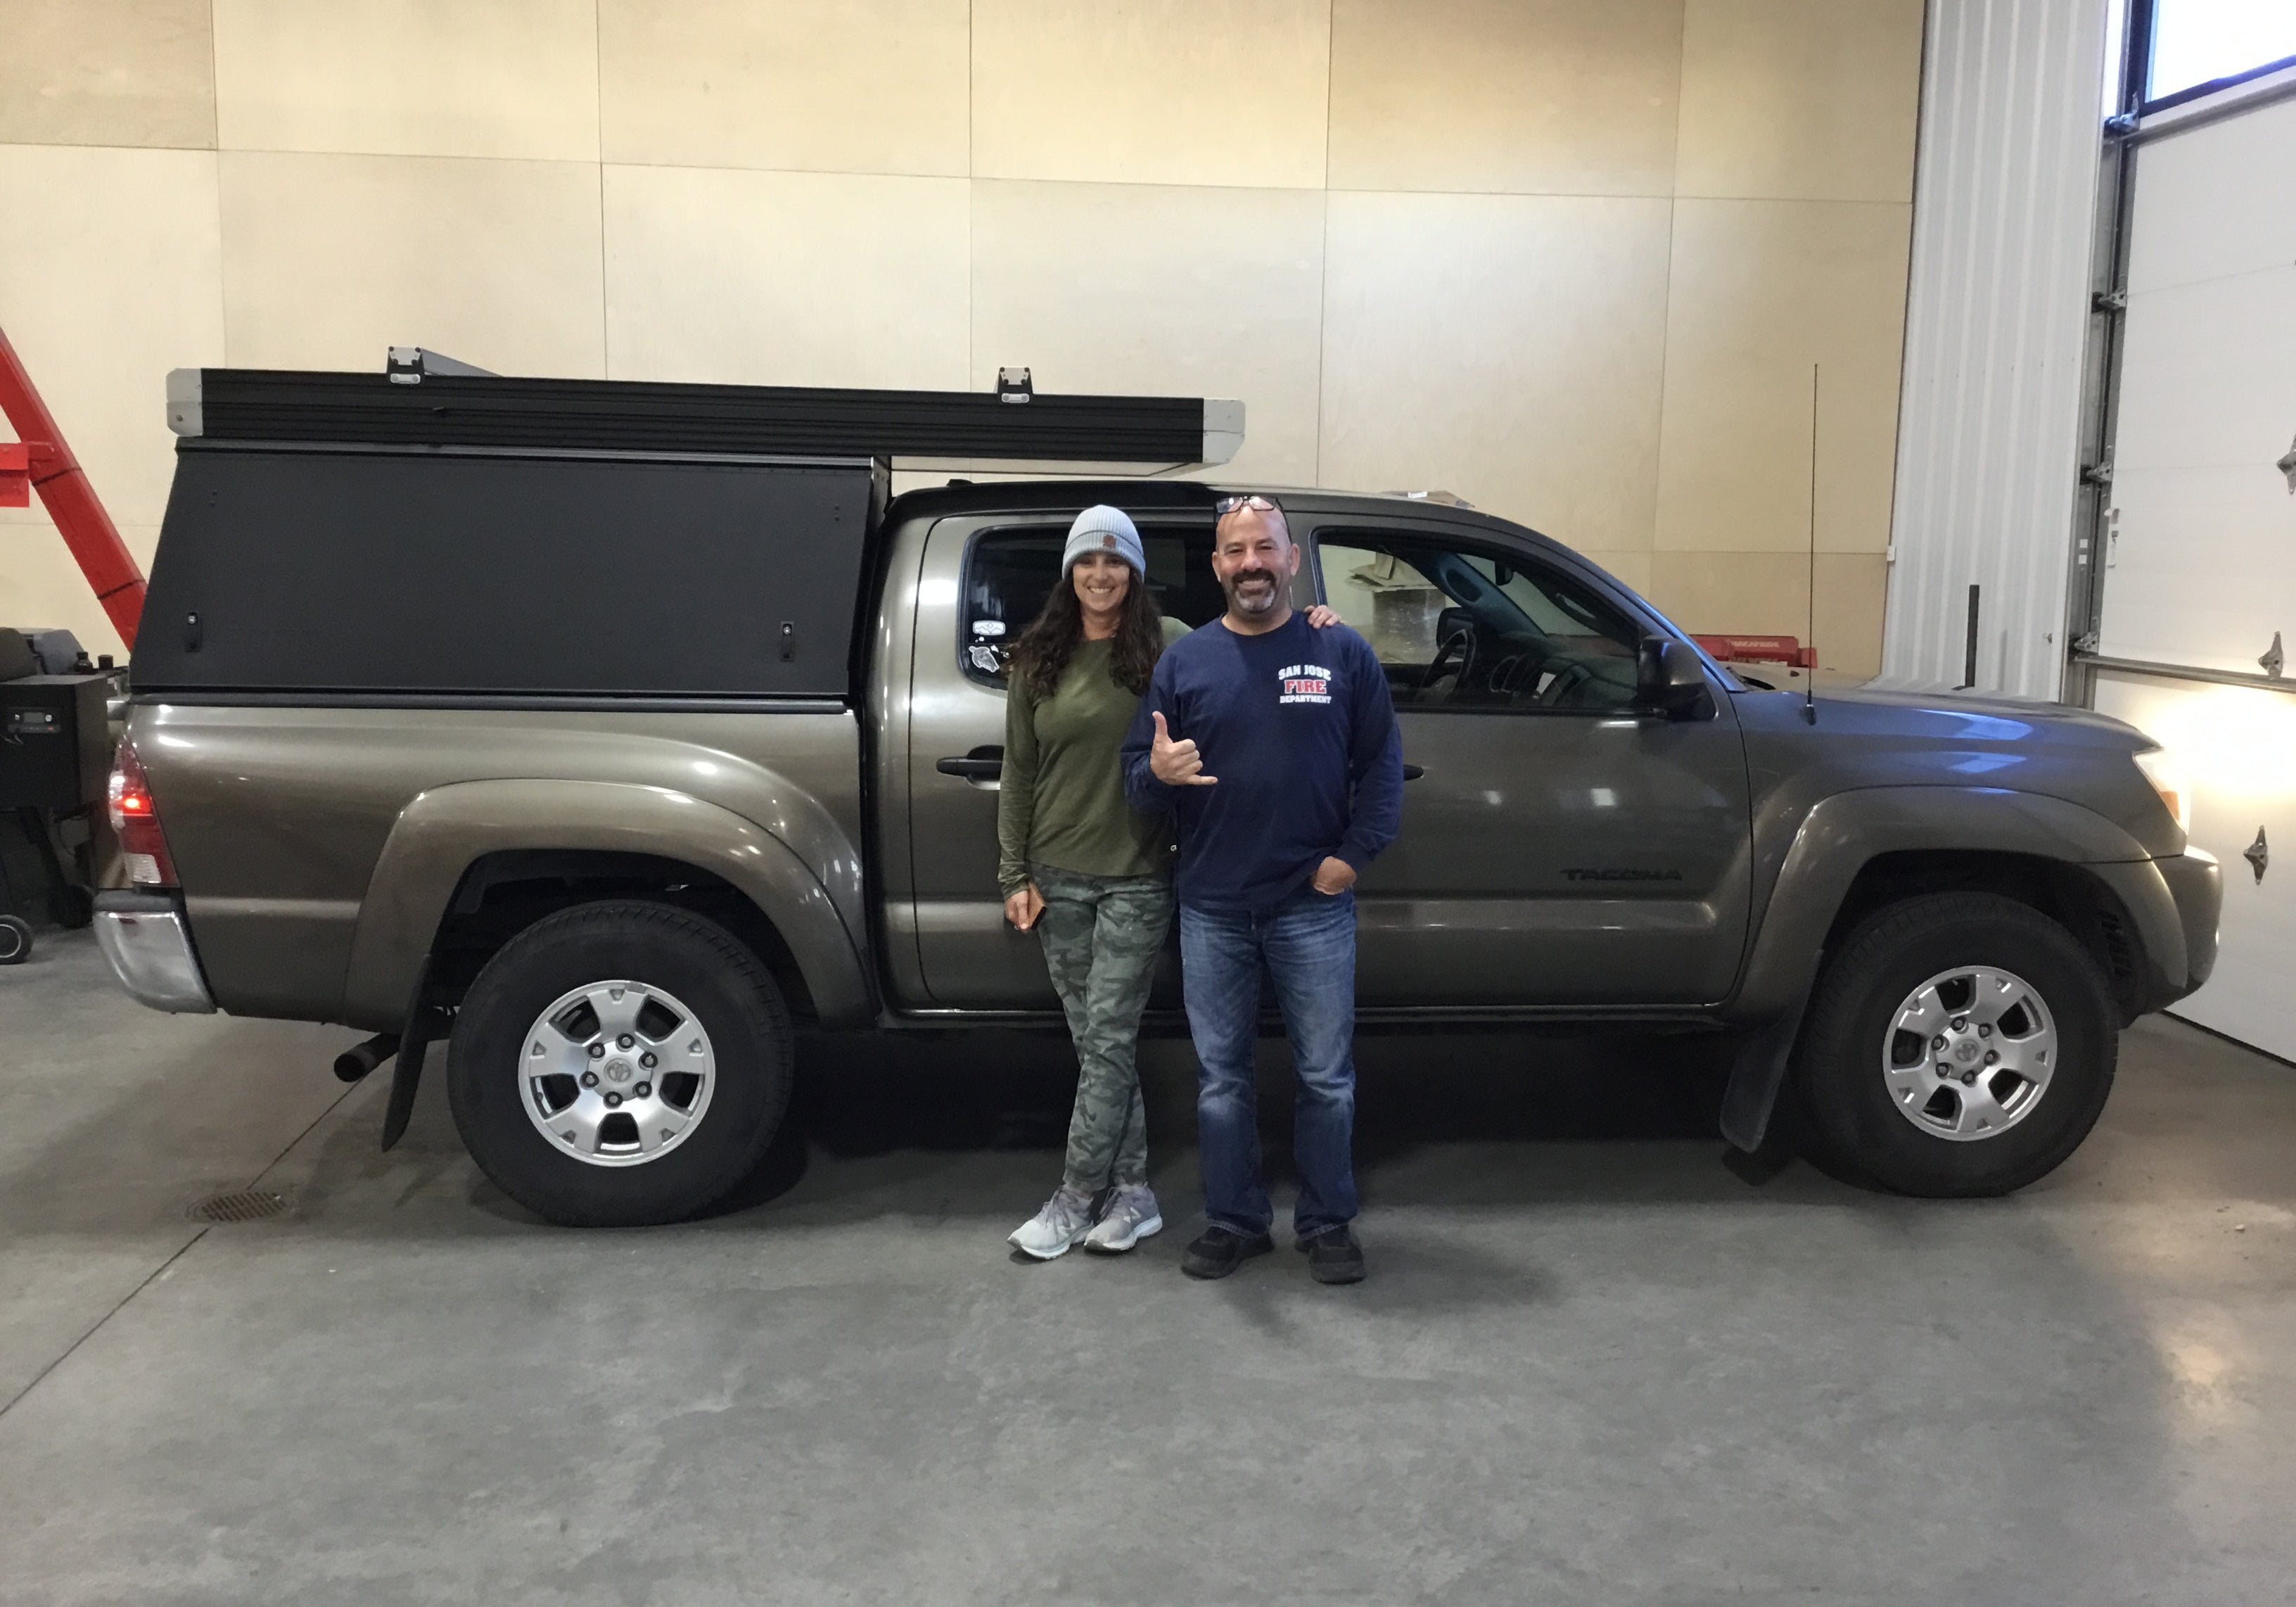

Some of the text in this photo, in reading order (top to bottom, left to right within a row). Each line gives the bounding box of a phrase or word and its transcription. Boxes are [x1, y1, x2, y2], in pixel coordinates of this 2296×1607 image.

[1278, 664, 1331, 680] SAN JOSE
[1284, 679, 1326, 693] FIRE
[1280, 695, 1331, 704] DEPARTMENT
[1560, 869, 1683, 880] TACOMA
